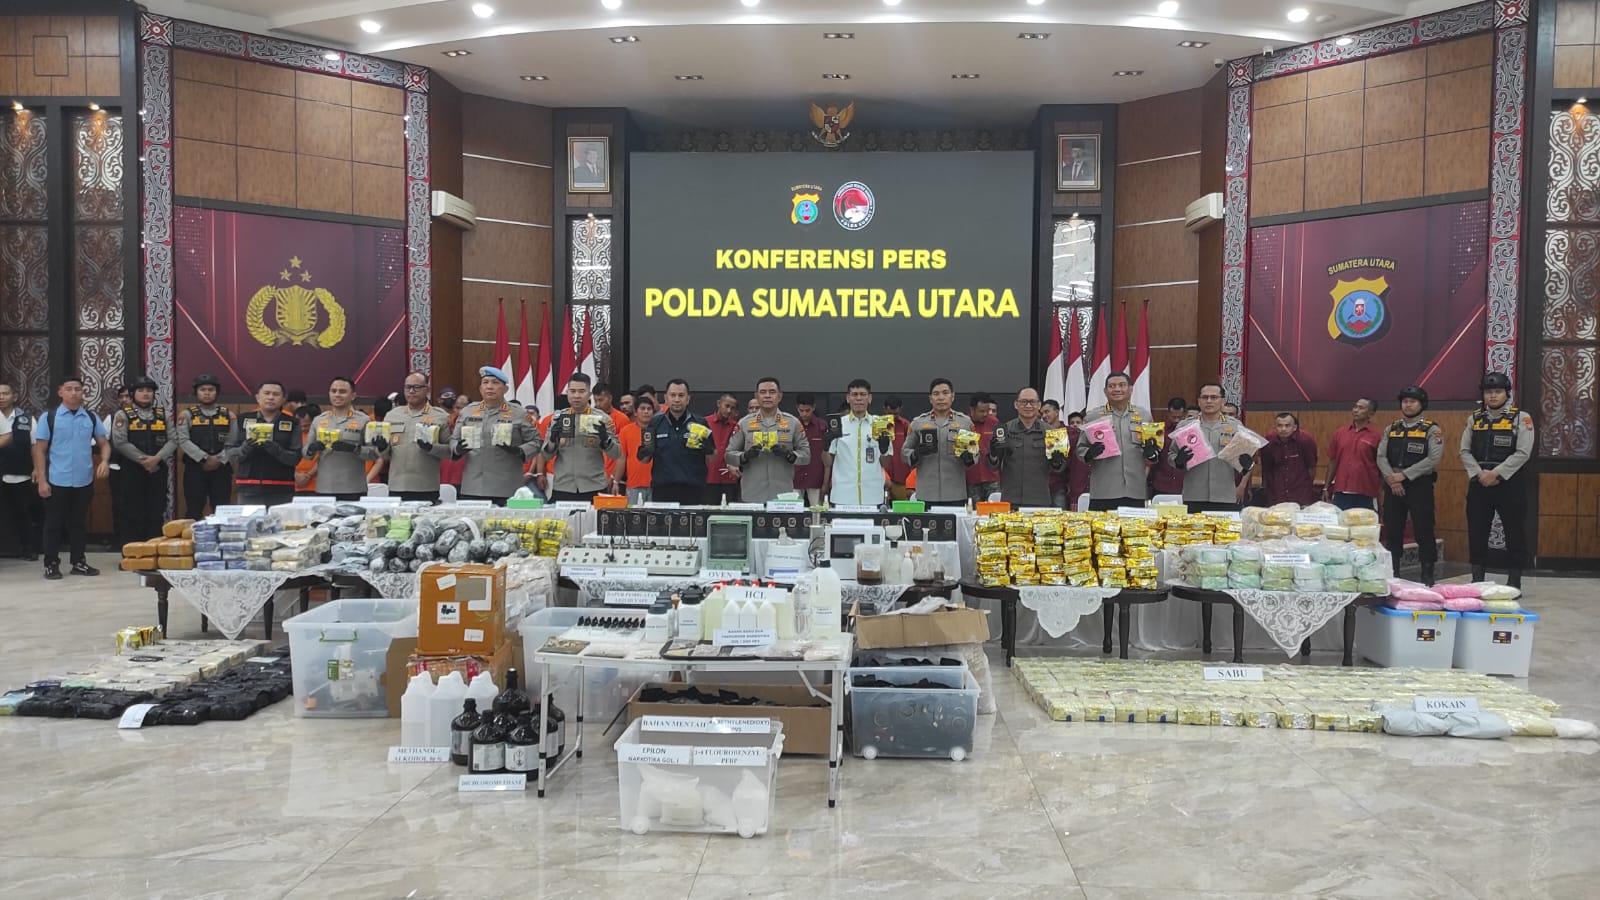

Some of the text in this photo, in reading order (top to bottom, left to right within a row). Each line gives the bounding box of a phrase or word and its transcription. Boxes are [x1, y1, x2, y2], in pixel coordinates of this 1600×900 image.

[716, 249, 947, 269] KONFERENSI PERS
[1327, 258, 1395, 275] SUMATERA UTARA
[645, 288, 1020, 318] POLDA SUMATERA UTARA
[745, 590, 766, 599] HCL
[1218, 669, 1248, 678] SABU
[1426, 700, 1467, 709] KOKAIN
